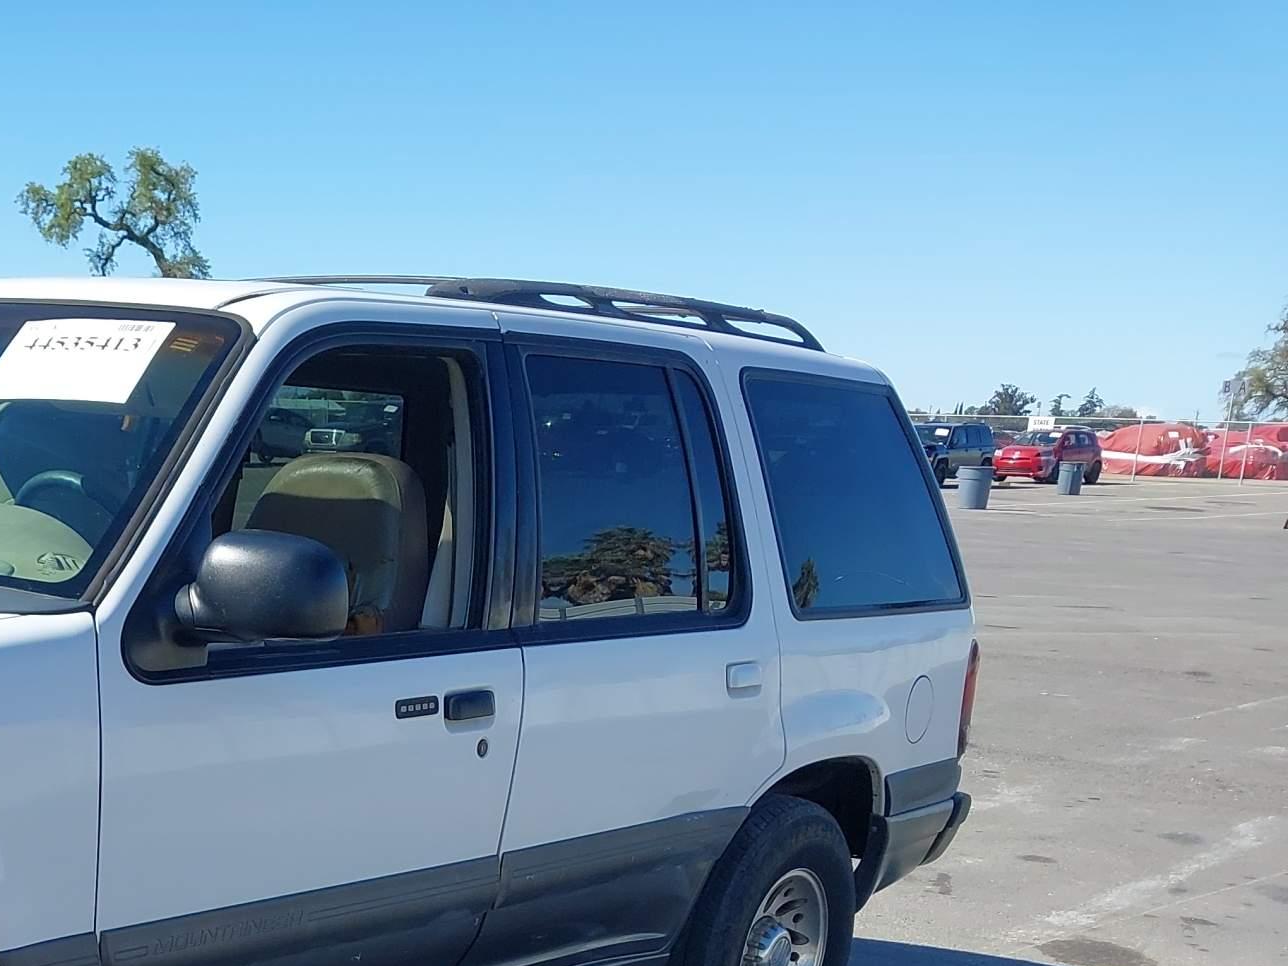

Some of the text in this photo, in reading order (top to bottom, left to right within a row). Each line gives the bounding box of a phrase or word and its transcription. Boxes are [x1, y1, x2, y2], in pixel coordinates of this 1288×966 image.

[24, 335, 143, 352] 44535413
[1224, 380, 1246, 393] B A
